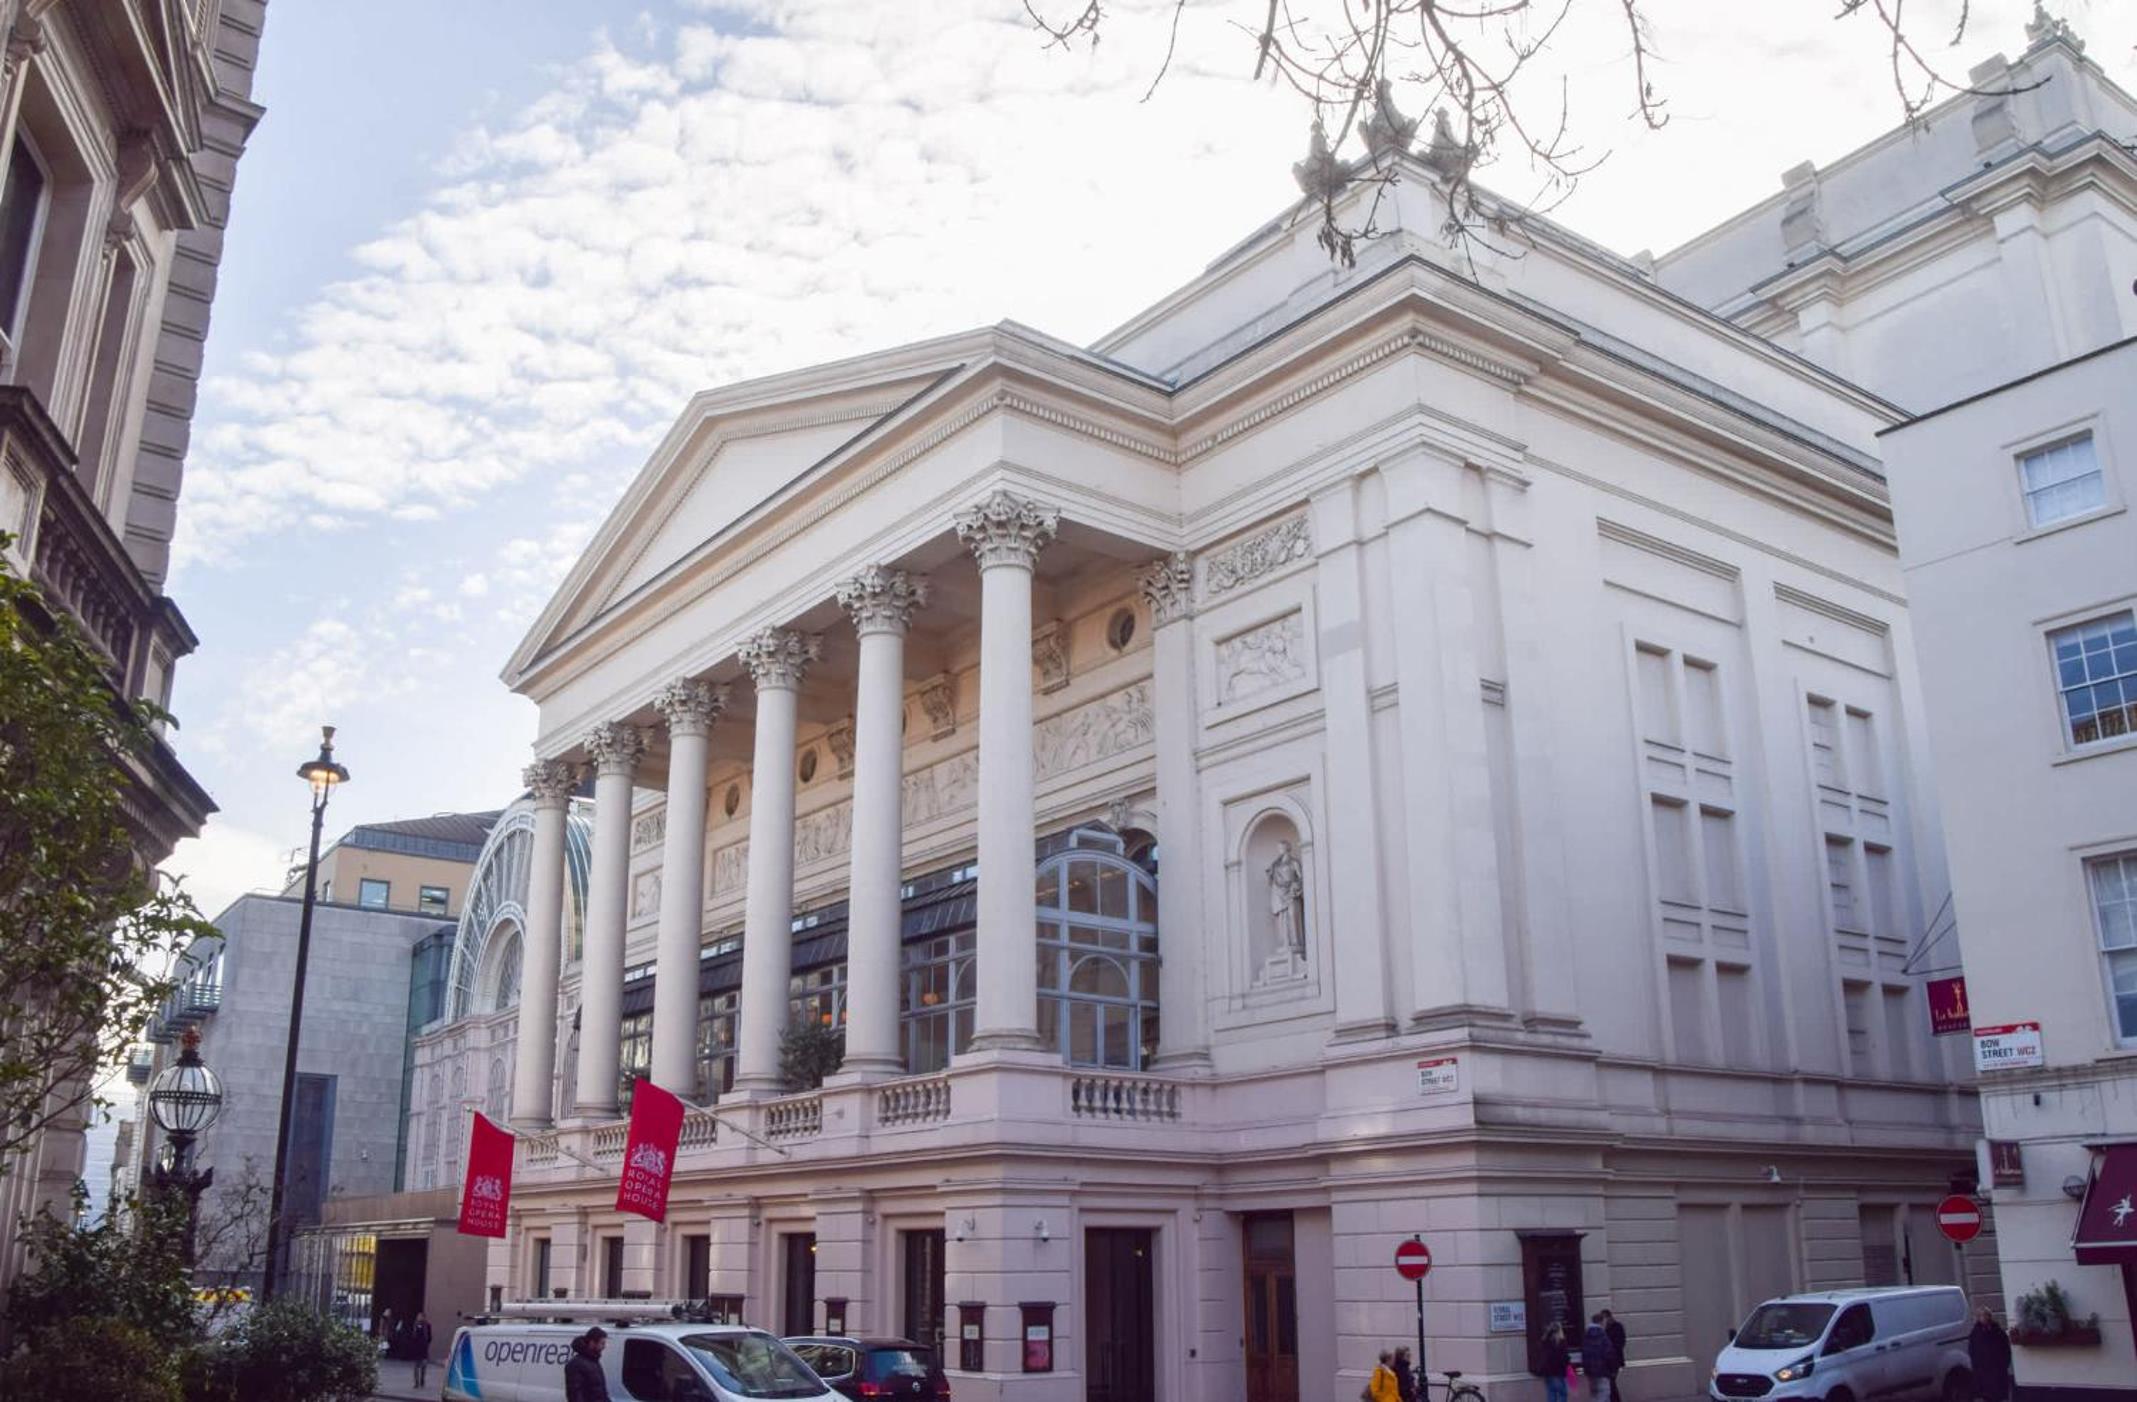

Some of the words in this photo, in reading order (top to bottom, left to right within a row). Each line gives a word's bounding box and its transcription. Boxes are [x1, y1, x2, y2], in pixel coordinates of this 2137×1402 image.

[1980, 1039, 2000, 1048] BOW
[1982, 1047, 2013, 1059] STREET
[2017, 1046, 2036, 1056] WC2
[628, 1169, 661, 1188] ROYAL
[625, 1180, 661, 1199] OPERA
[624, 1192, 659, 1210] HOUSE
[468, 1208, 501, 1220] OPERA
